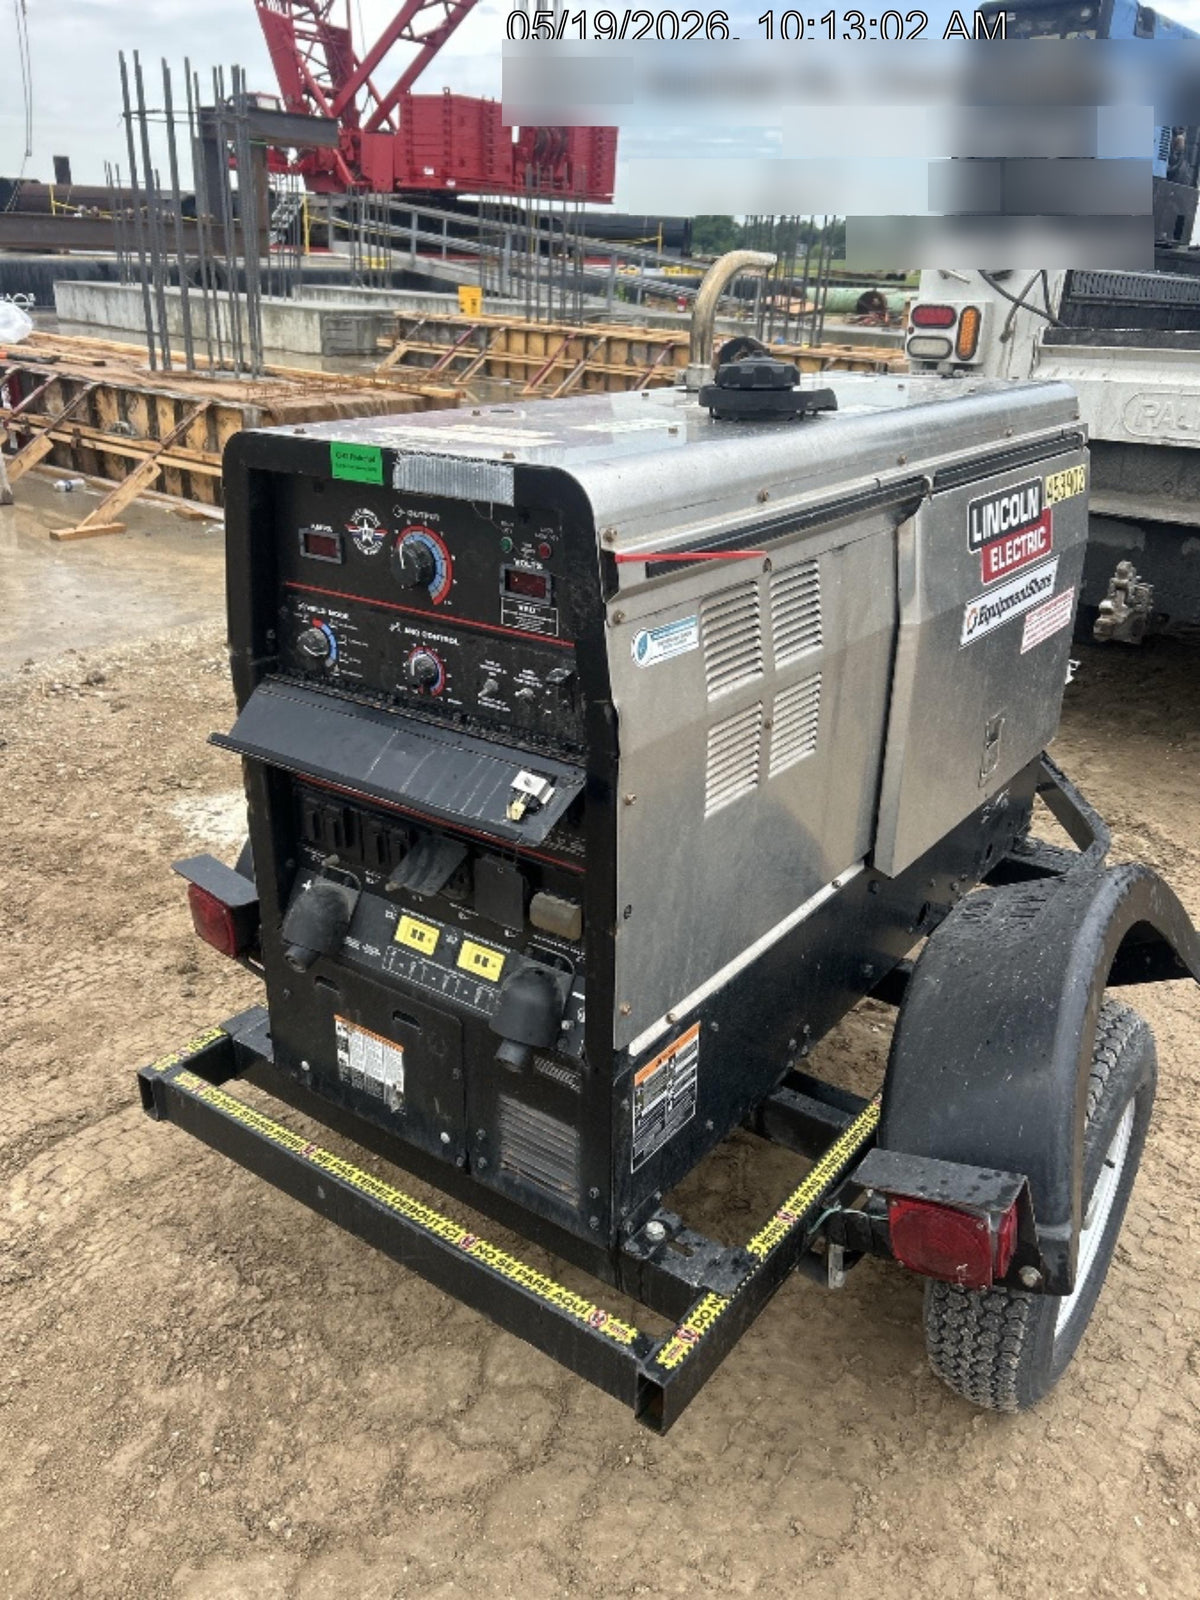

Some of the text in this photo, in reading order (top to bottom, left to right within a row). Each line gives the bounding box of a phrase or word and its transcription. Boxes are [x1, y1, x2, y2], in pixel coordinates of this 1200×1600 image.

[1134, 399, 1200, 433] PAL
[972, 486, 1040, 543] LINCOLN
[990, 525, 1047, 573] ELECTRIC
[392, 1195, 443, 1227] DEBOUT
[441, 1223, 461, 1239] ICI
[474, 1244, 497, 1260] NO
[495, 1257, 516, 1273] SE
[515, 1268, 553, 1294] PARE
[692, 1309, 712, 1329] DO
